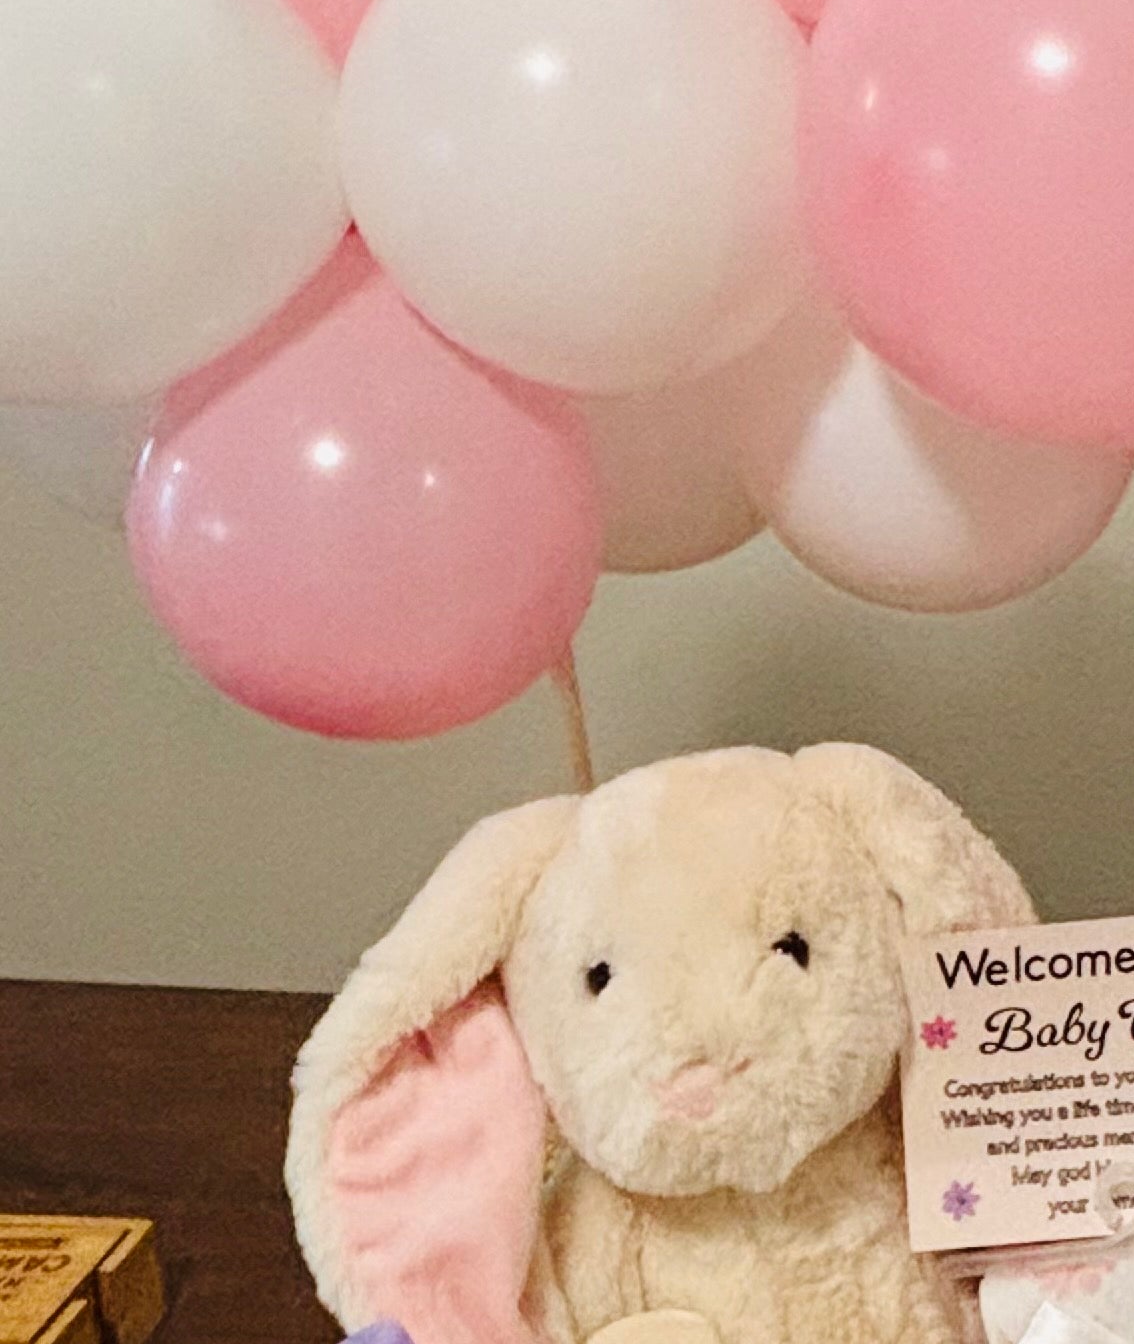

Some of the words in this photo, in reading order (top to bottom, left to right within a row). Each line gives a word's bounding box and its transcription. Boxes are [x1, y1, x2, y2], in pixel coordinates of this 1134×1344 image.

[979, 1002, 1113, 1060] Baby
[944, 1070, 1085, 1099] Congratulations
[1091, 1071, 1109, 1087] to
[940, 1106, 1014, 1130] Wishing
[1018, 1105, 1051, 1126] you
[1057, 1107, 1068, 1120] a
[1073, 1099, 1100, 1119] life
[987, 1135, 1019, 1155] and
[1025, 1132, 1097, 1156] precious
[1011, 1164, 1052, 1187] May
[1058, 1160, 1091, 1186] god
[1048, 1197, 1089, 1220] your
